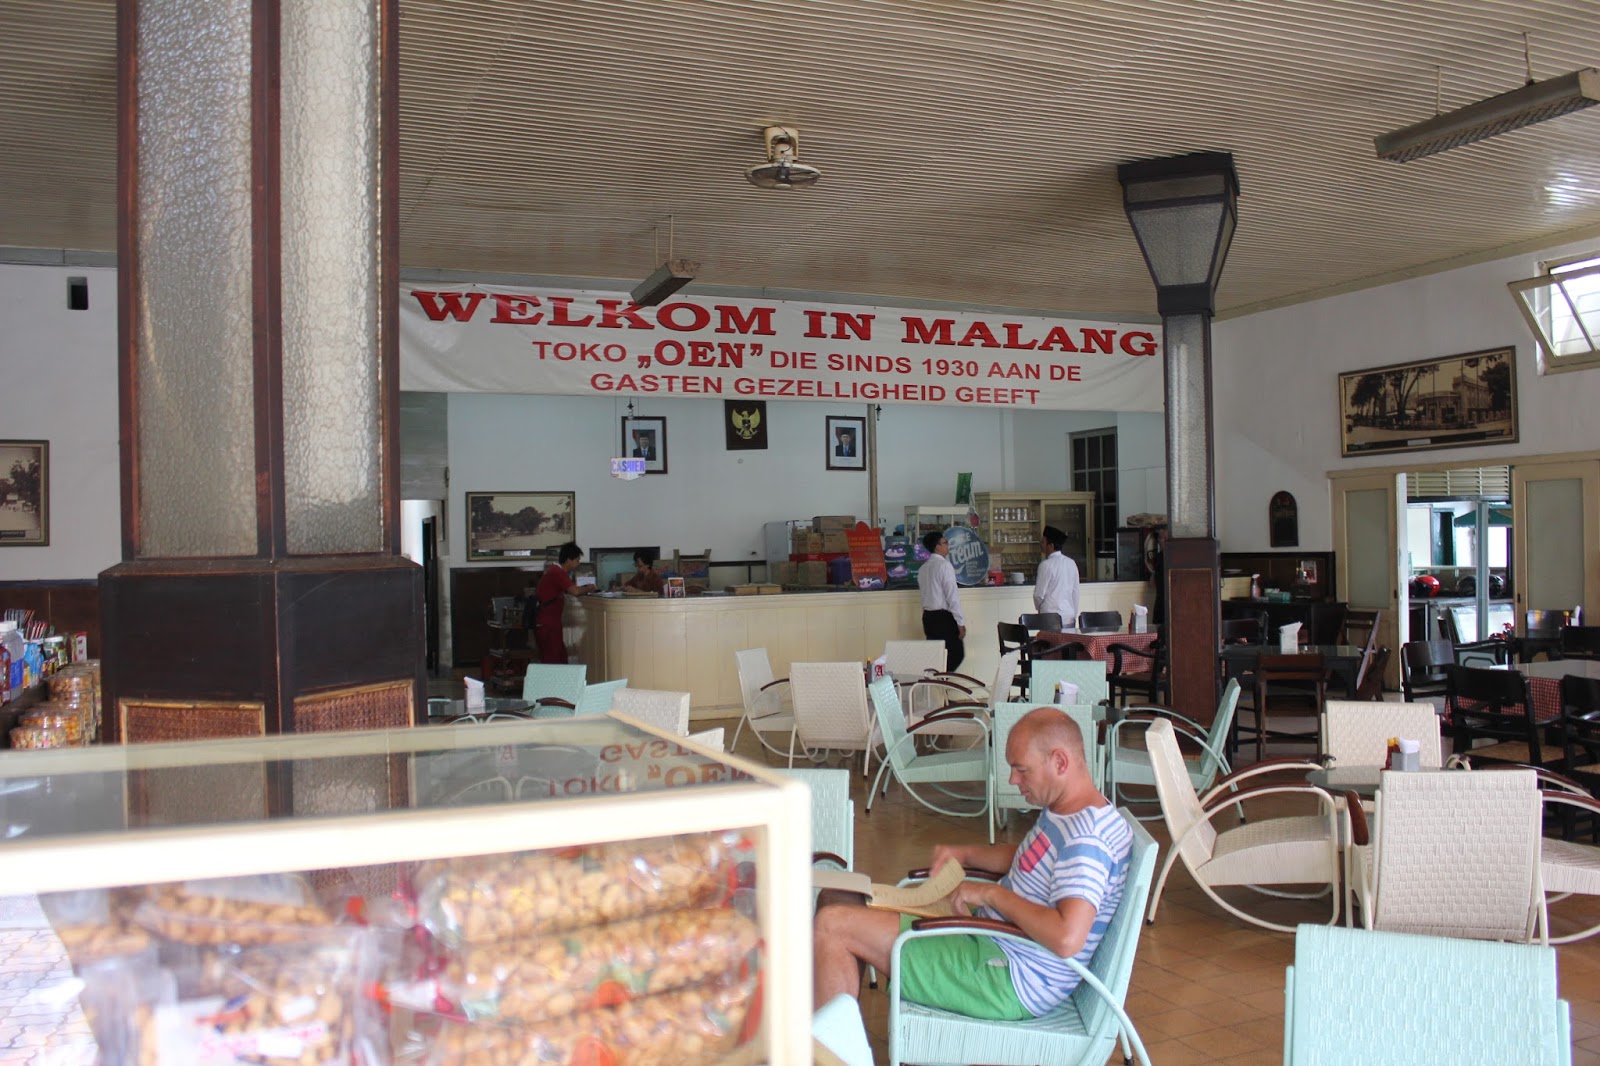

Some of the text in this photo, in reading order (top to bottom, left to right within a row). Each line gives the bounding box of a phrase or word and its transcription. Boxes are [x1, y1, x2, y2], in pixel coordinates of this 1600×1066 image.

[411, 289, 1159, 357] WELKOM IN MALANG
[532, 340, 628, 363] TOKO
[769, 350, 818, 371] DIE
[827, 353, 913, 376] SINDS
[922, 358, 980, 377] 1930
[987, 361, 1041, 380] AAN
[1048, 364, 1082, 382] DE
[590, 372, 1040, 405] GASTEN GEZELLIGHEID GEEFT
[611, 460, 645, 472] CASHIER
